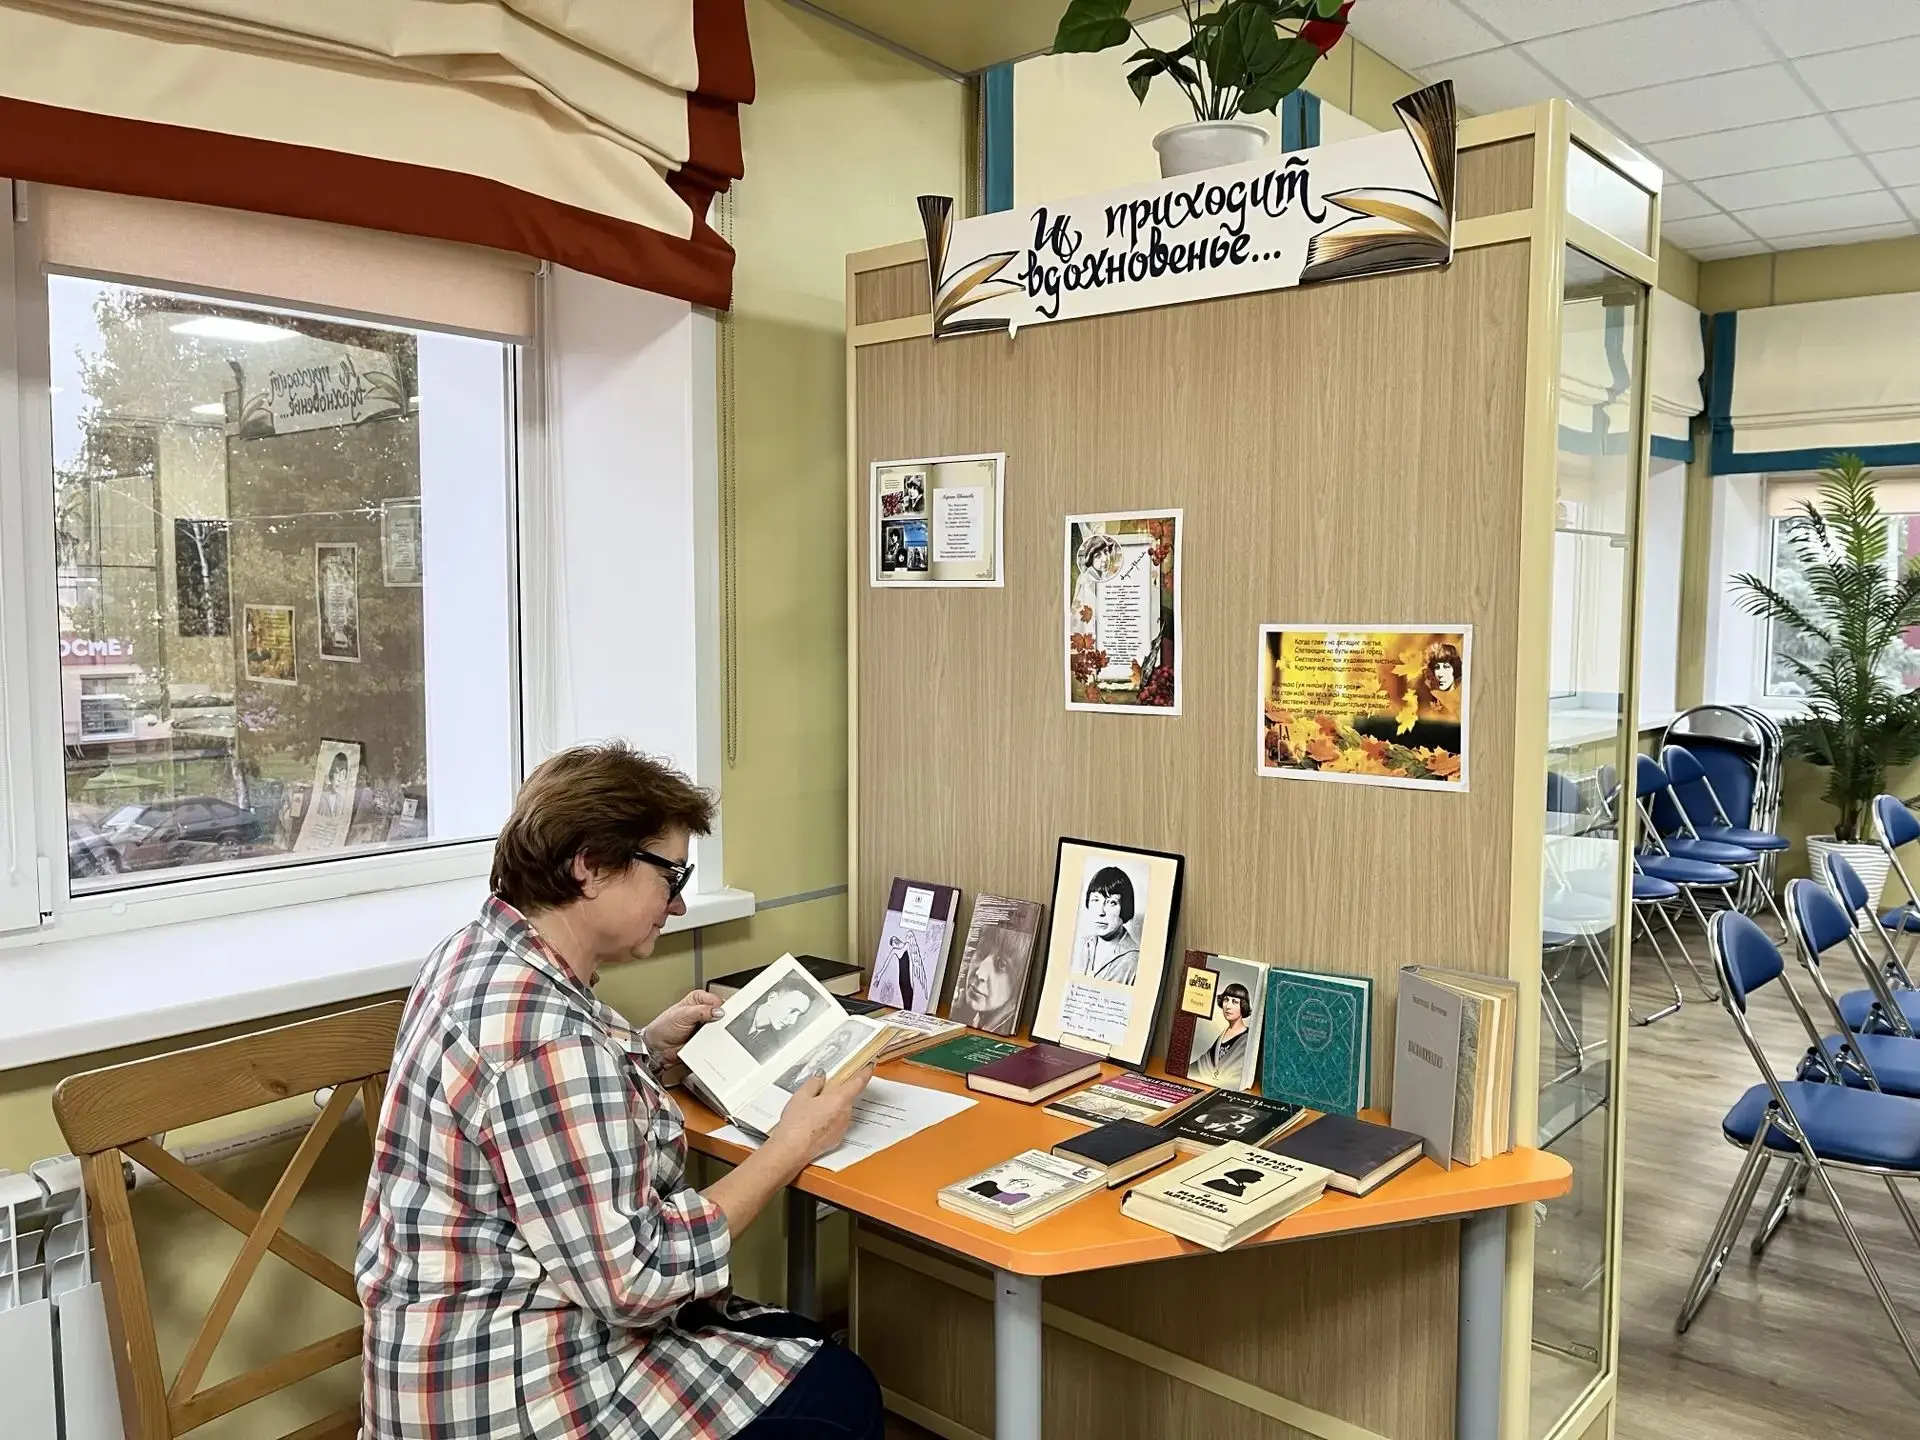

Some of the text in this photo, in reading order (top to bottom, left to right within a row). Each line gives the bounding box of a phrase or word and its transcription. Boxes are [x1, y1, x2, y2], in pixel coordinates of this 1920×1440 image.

[1030, 156, 1327, 263] И приходит
[1019, 226, 1281, 318] вдохновенье...
[1245, 1152, 1304, 1172] АРИАДНА
[1246, 1157, 1289, 1172] ЭФРОН
[1163, 1190, 1229, 1214] ЦВЕТАЕВОЙ
[1177, 1190, 1227, 1208] МАРИНЕ
